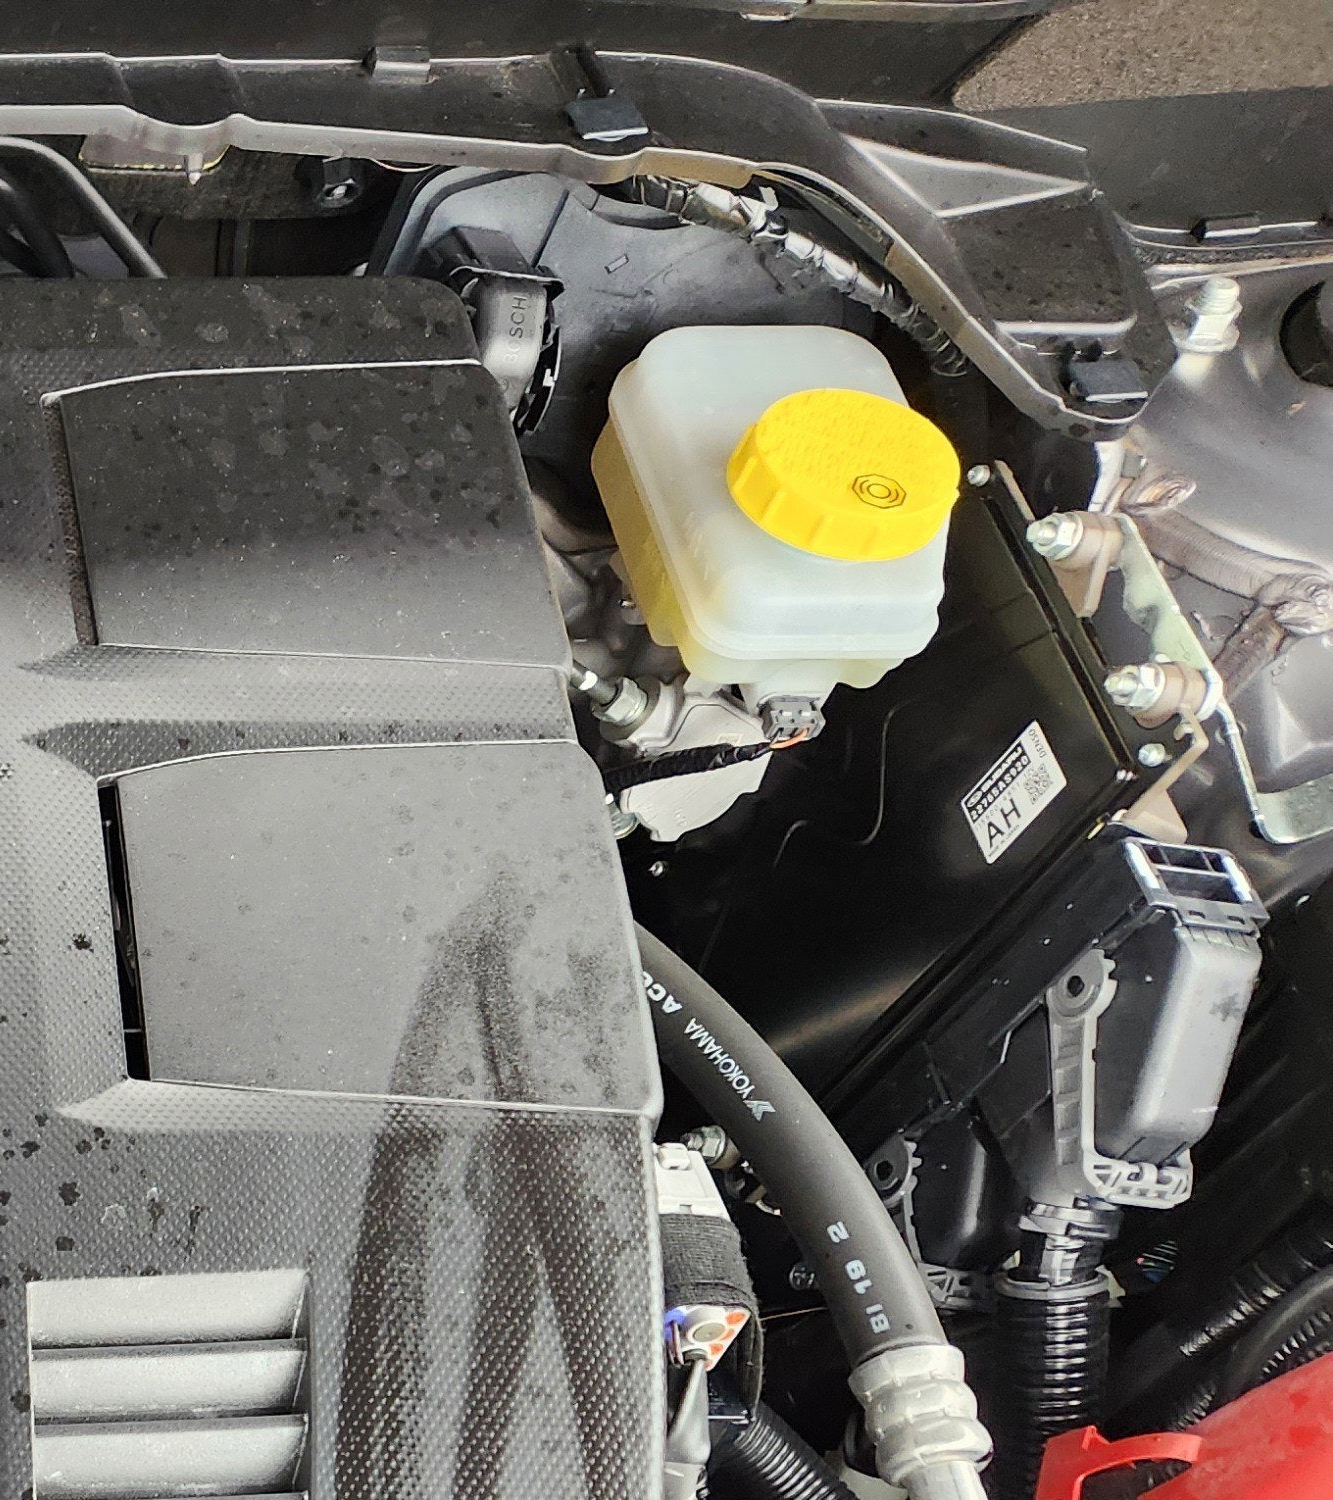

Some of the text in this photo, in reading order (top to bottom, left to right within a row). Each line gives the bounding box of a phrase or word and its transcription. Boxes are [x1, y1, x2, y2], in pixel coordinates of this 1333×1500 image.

[504, 294, 528, 361] BOSCH
[986, 797, 1022, 849] AH
[683, 1017, 756, 1100] YOKOHAMA
[826, 1220, 850, 1243] 2
